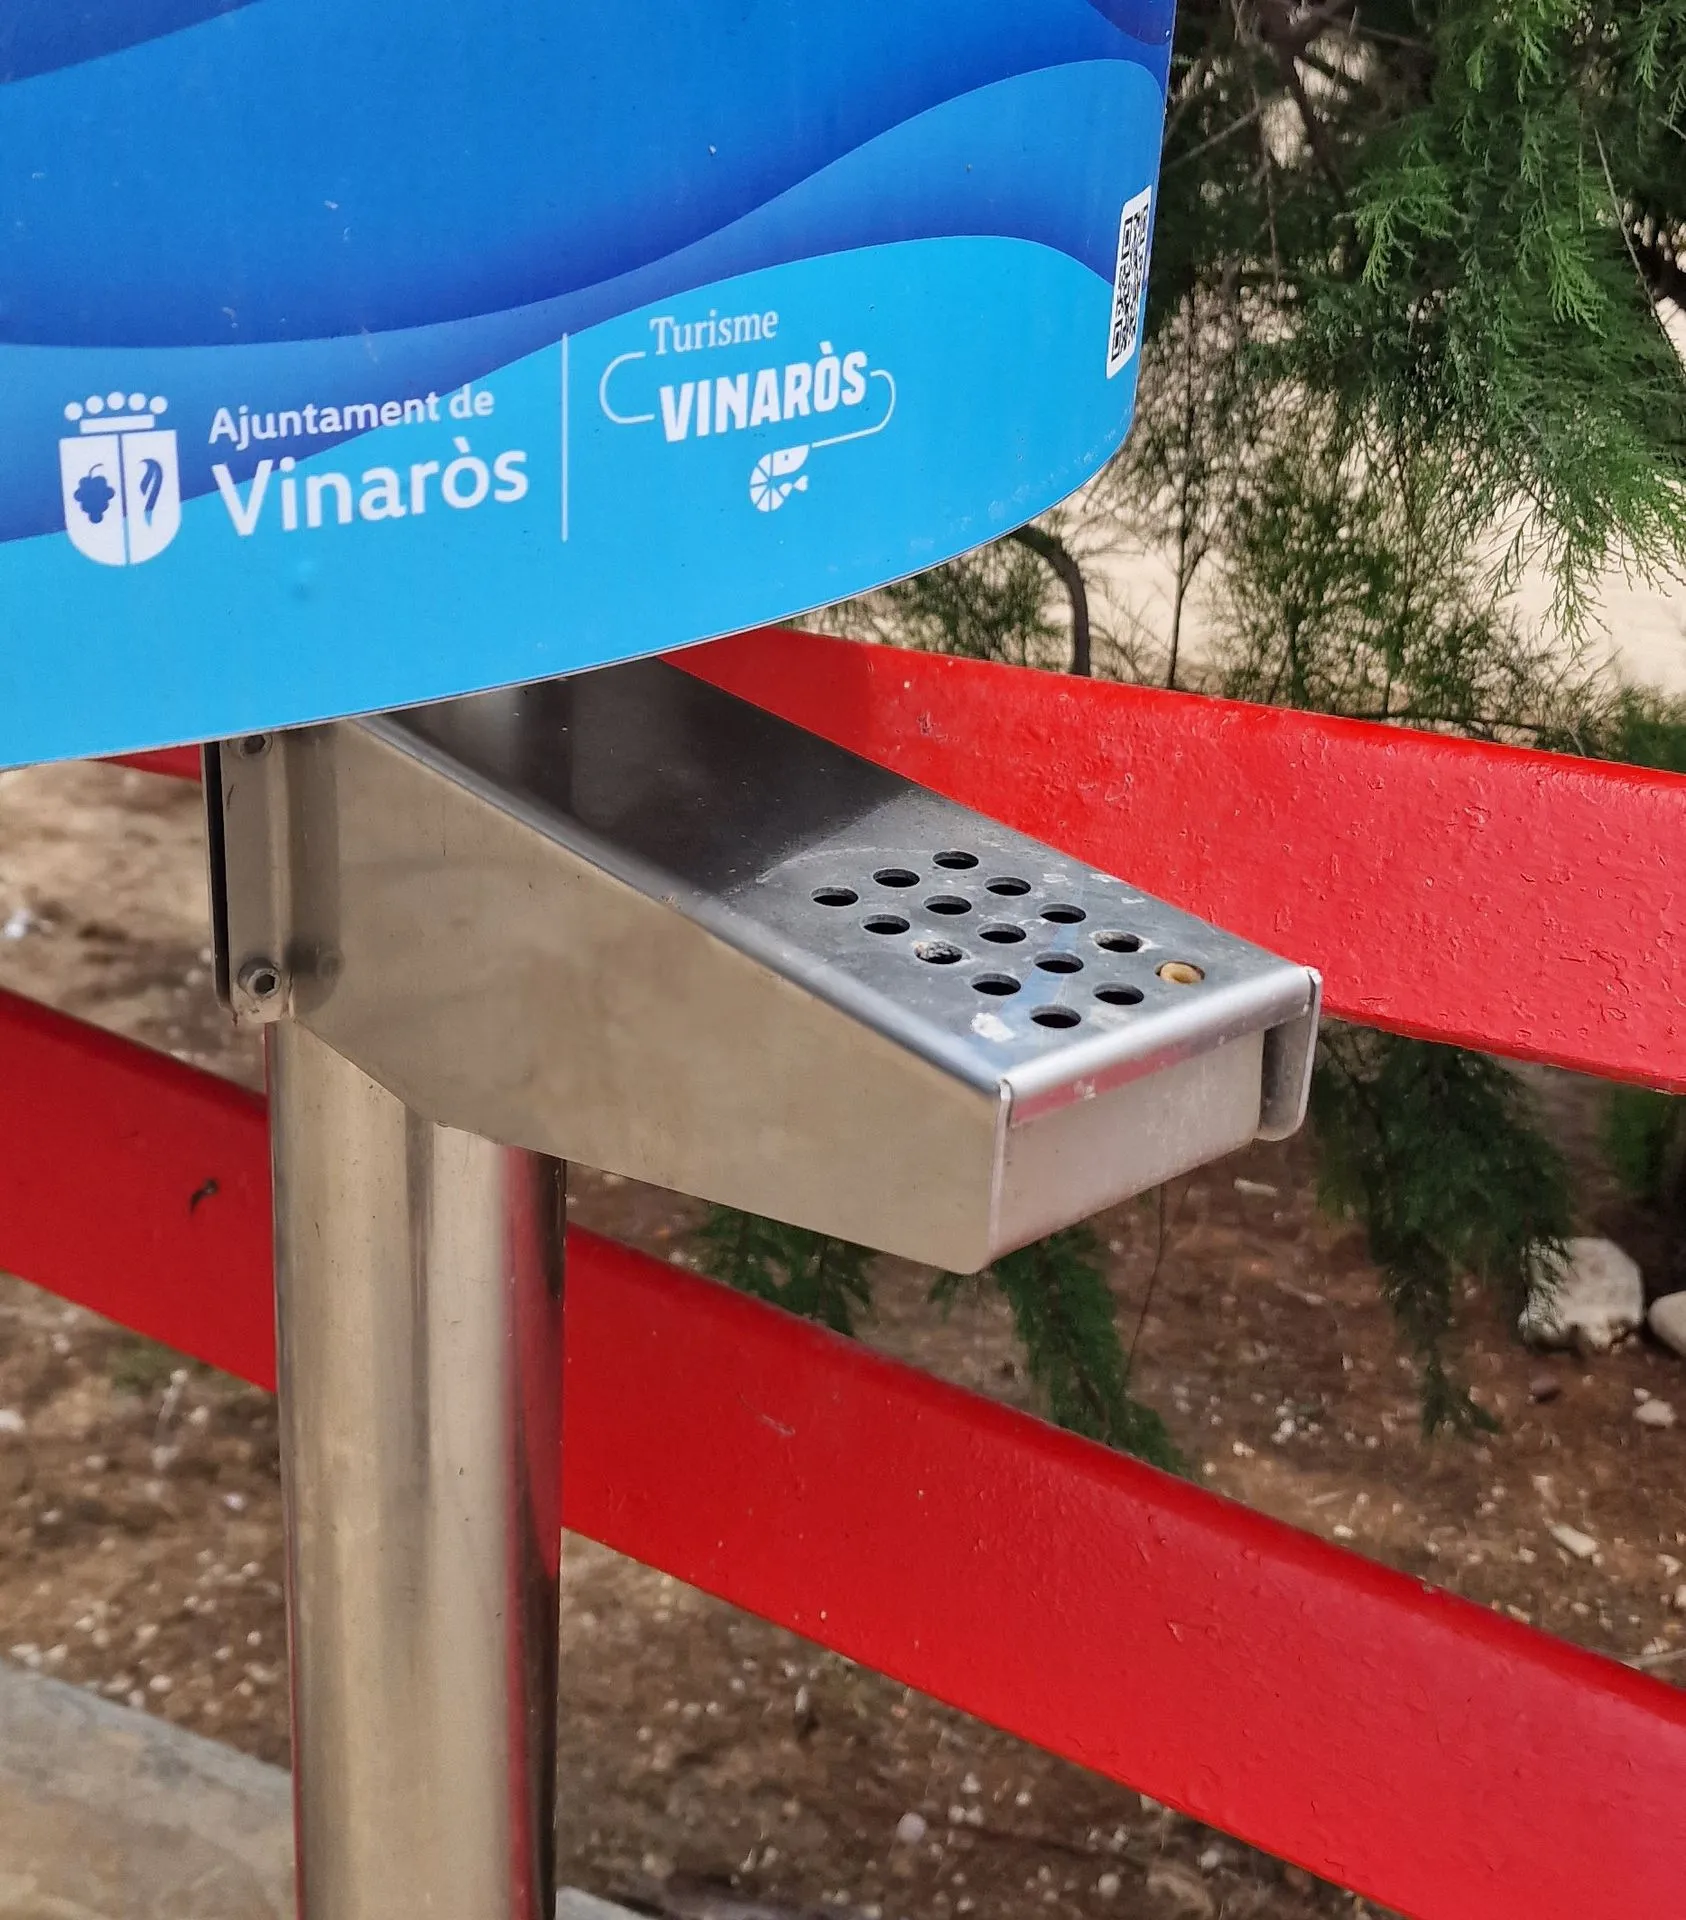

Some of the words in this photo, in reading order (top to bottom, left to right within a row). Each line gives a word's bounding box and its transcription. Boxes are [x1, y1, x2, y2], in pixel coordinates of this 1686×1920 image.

[649, 309, 778, 356] Turisme
[208, 391, 440, 447] Ajuntament
[450, 384, 495, 418] de
[659, 341, 868, 442] VINARÒS
[212, 438, 528, 537] Vinaròs
